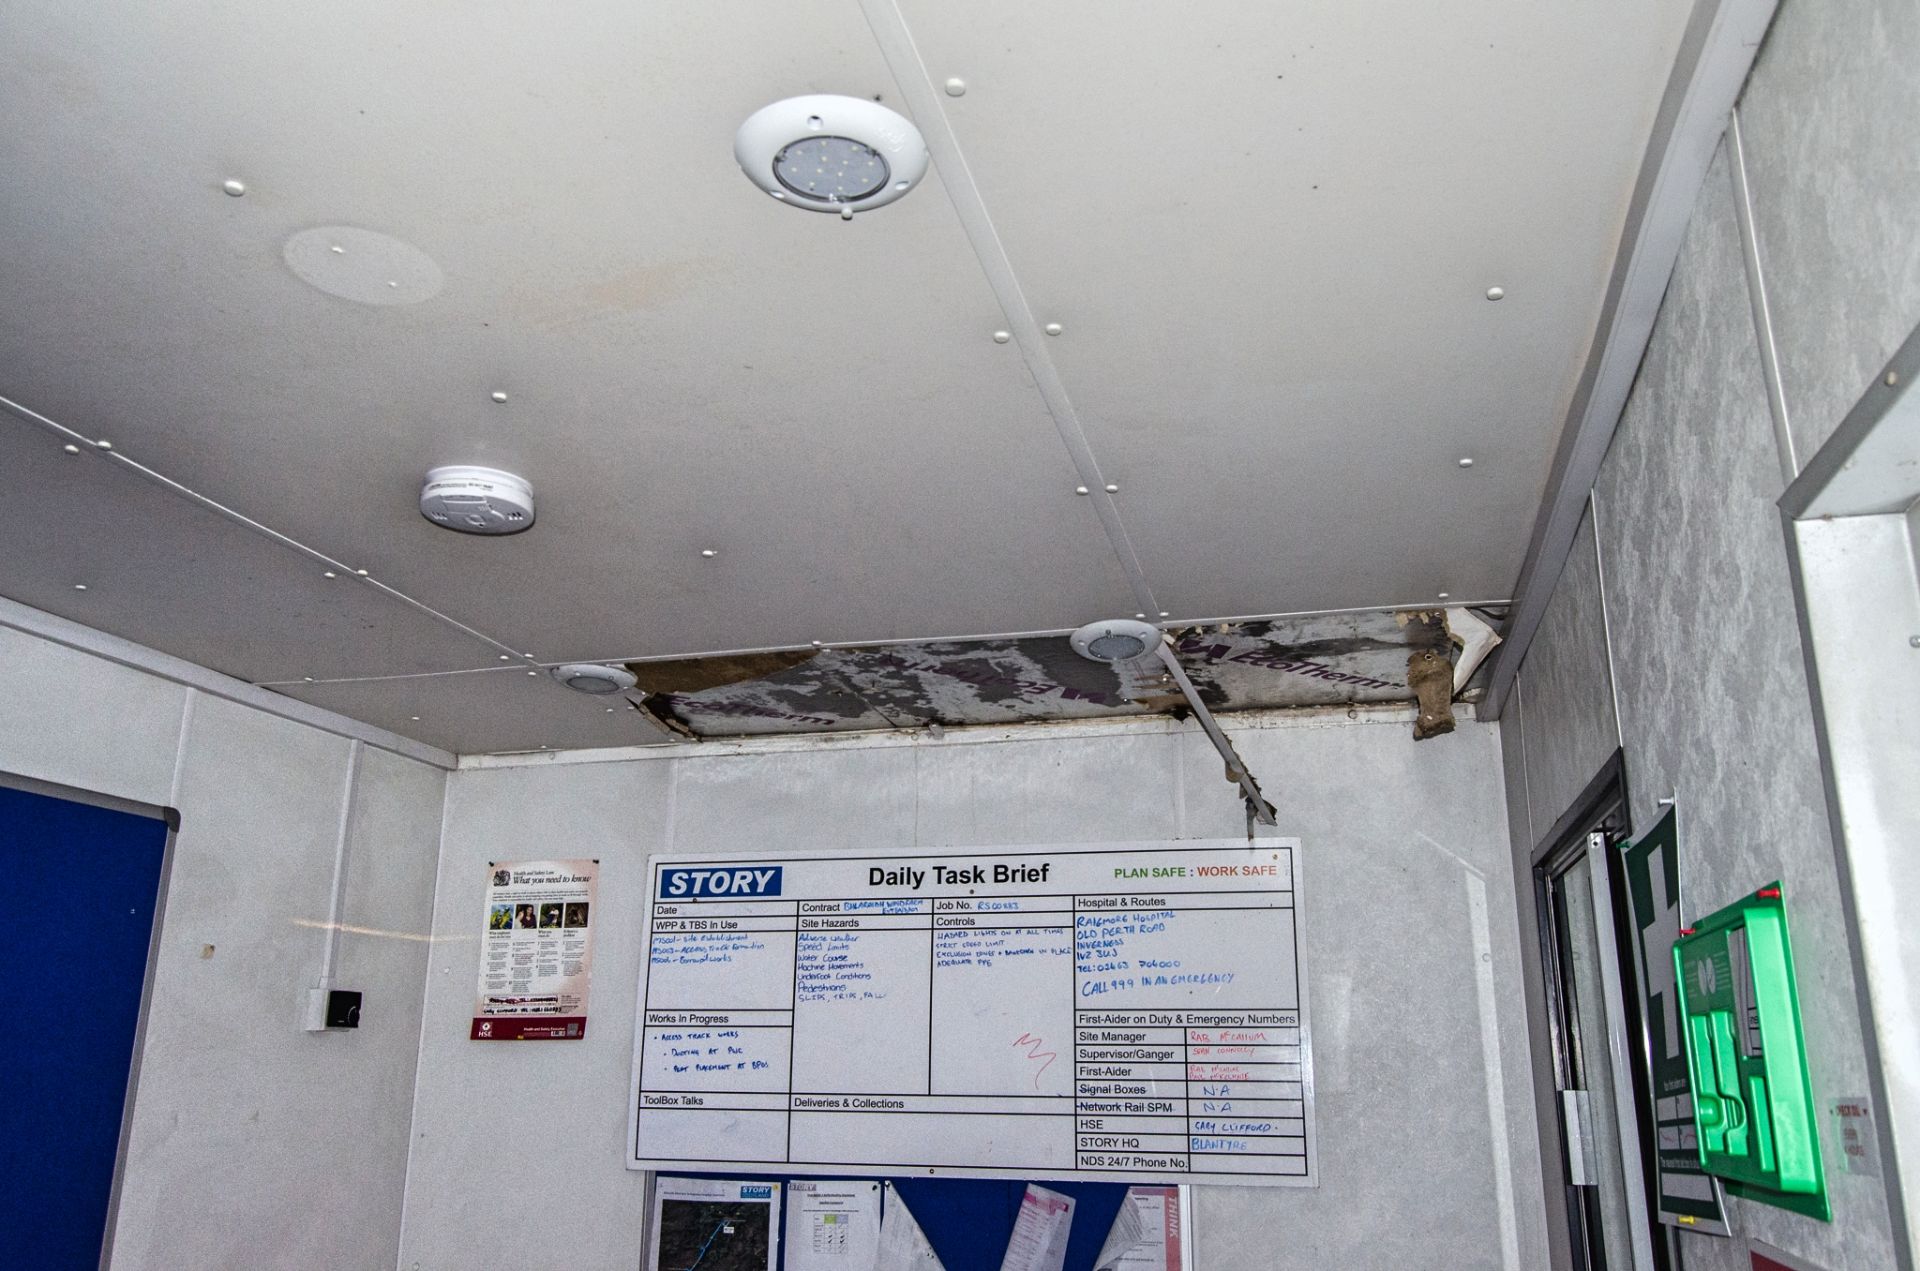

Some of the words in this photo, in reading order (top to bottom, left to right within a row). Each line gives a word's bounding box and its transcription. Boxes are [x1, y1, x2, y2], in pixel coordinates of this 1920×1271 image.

[1228, 651, 1391, 690] EcoTherm
[869, 867, 925, 890] Daily
[932, 865, 985, 885] Task
[993, 863, 1050, 883] Brief
[1114, 868, 1148, 879] PLAN
[1152, 867, 1186, 877] SAFE
[1197, 866, 1239, 877] WORK
[1242, 865, 1277, 876] SAFE
[514, 876, 530, 884] What
[530, 877, 545, 886] you
[545, 875, 562, 883] need
[571, 875, 592, 883] know
[669, 870, 775, 895] STORY
[802, 903, 840, 912] Contract
[936, 901, 953, 910] Job
[956, 901, 972, 910] No.
[1078, 898, 1117, 909] Hospital
[1120, 897, 1128, 906] &
[1131, 897, 1166, 906] Routes
[657, 906, 678, 915] Date
[656, 921, 678, 930] WPP
[680, 920, 686, 930] &
[689, 920, 707, 929] TBS
[710, 921, 718, 929] In
[721, 920, 738, 929] Use
[801, 919, 819, 928] Site
[821, 918, 860, 928] Hazards
[936, 917, 976, 926] Controls
[1077, 930, 1097, 940] OLD
[1140, 923, 1165, 933] ROAD
[1082, 981, 1109, 997] CALL
[1111, 979, 1134, 991] 999
[1142, 976, 1152, 986] IN
[1155, 975, 1167, 985] AN
[1171, 973, 1234, 985] EMERGENCY
[649, 1014, 676, 1023] Works
[679, 1014, 687, 1023] In
[690, 1014, 729, 1025] Progress
[1079, 1014, 1131, 1024] First-Aider
[1133, 1016, 1146, 1024] on
[1150, 1015, 1173, 1026] Duty
[1175, 1015, 1184, 1024] &
[1187, 1015, 1243, 1027] Emergency
[1248, 1014, 1295, 1024] Numbers
[687, 1032, 711, 1040] TRACK
[1079, 1032, 1099, 1042] Site
[1101, 1032, 1146, 1044] Manager
[1079, 1050, 1175, 1061] Supervisor/Ganger
[1079, 1067, 1131, 1076] First-Aider
[1079, 1085, 1111, 1096] Signal
[1114, 1085, 1146, 1094] Boxes
[643, 1096, 679, 1105] ToolBox
[681, 1096, 704, 1105] Talks
[794, 1098, 841, 1108] Deliveries
[843, 1098, 850, 1108] &
[853, 1099, 904, 1109] Collections
[1080, 1102, 1121, 1112] Network
[1125, 1102, 1145, 1112] Rail
[1147, 1103, 1173, 1112] SPM
[1080, 1120, 1103, 1129] HSE
[1081, 1138, 1119, 1148] STORY
[1122, 1138, 1139, 1149] HQ
[1080, 1156, 1105, 1166] NDS
[1108, 1157, 1130, 1167] 24/7
[1133, 1158, 1167, 1168] Phone
[1170, 1158, 1188, 1169] No.
[1168, 1196, 1179, 1238] THINK
